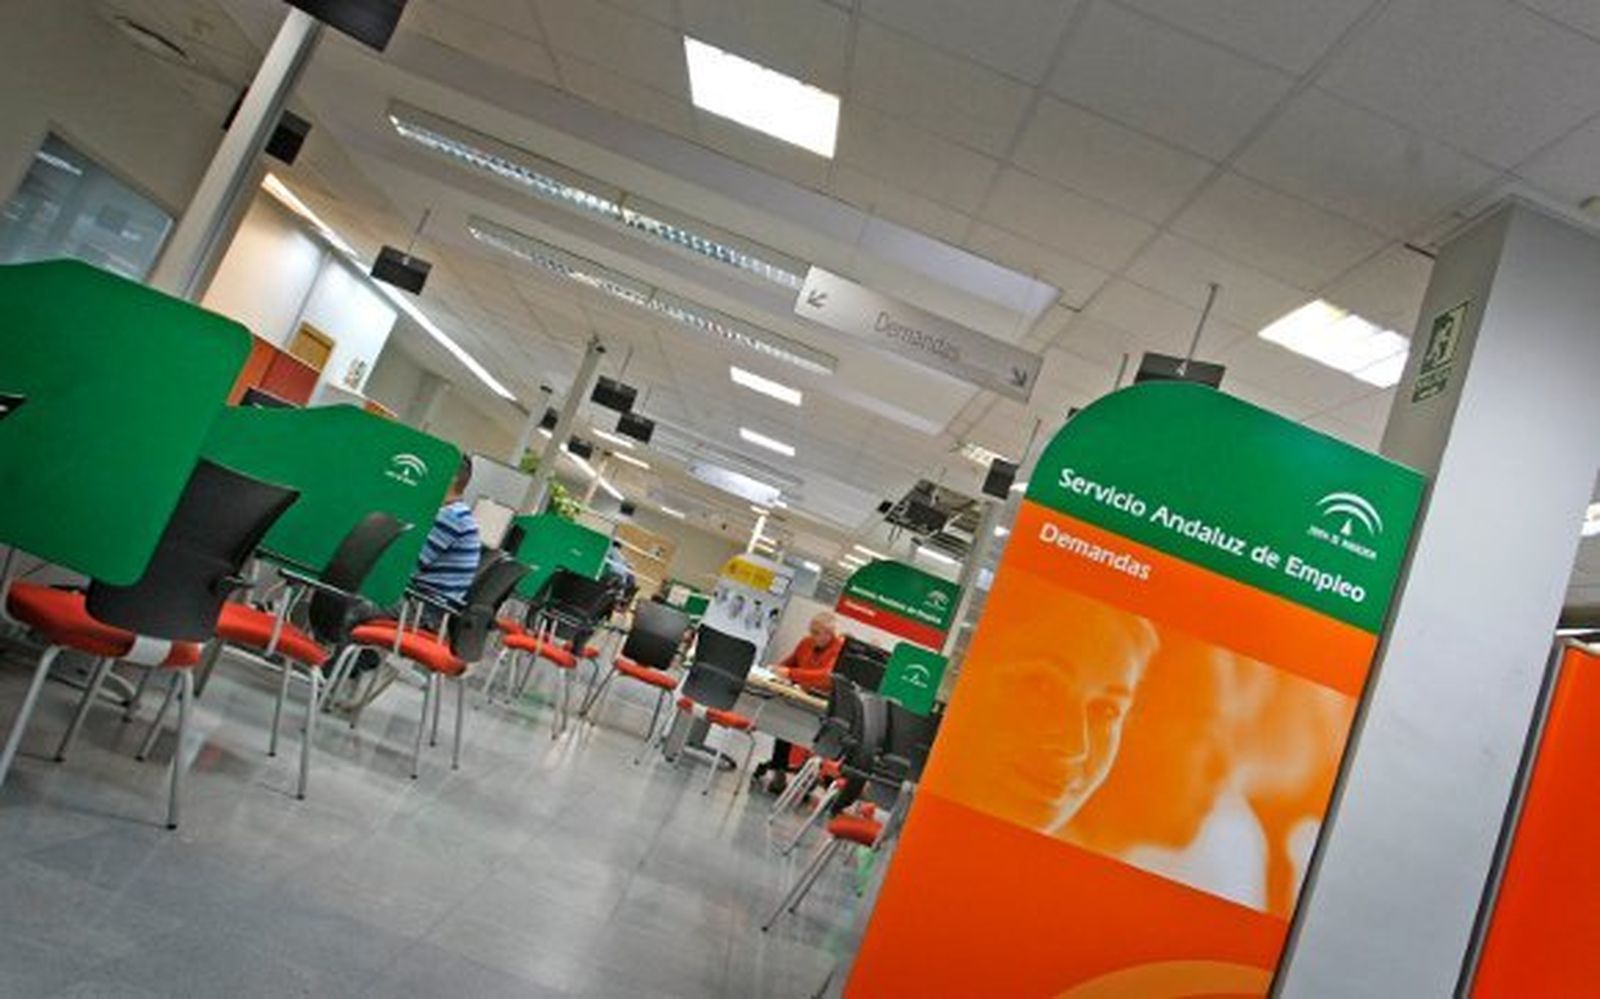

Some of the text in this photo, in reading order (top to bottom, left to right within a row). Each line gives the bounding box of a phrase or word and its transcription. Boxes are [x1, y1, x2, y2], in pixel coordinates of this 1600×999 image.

[1039, 522, 1152, 581] Demandas
[1058, 468, 1366, 602] Servicio Andaluz de Empleo
